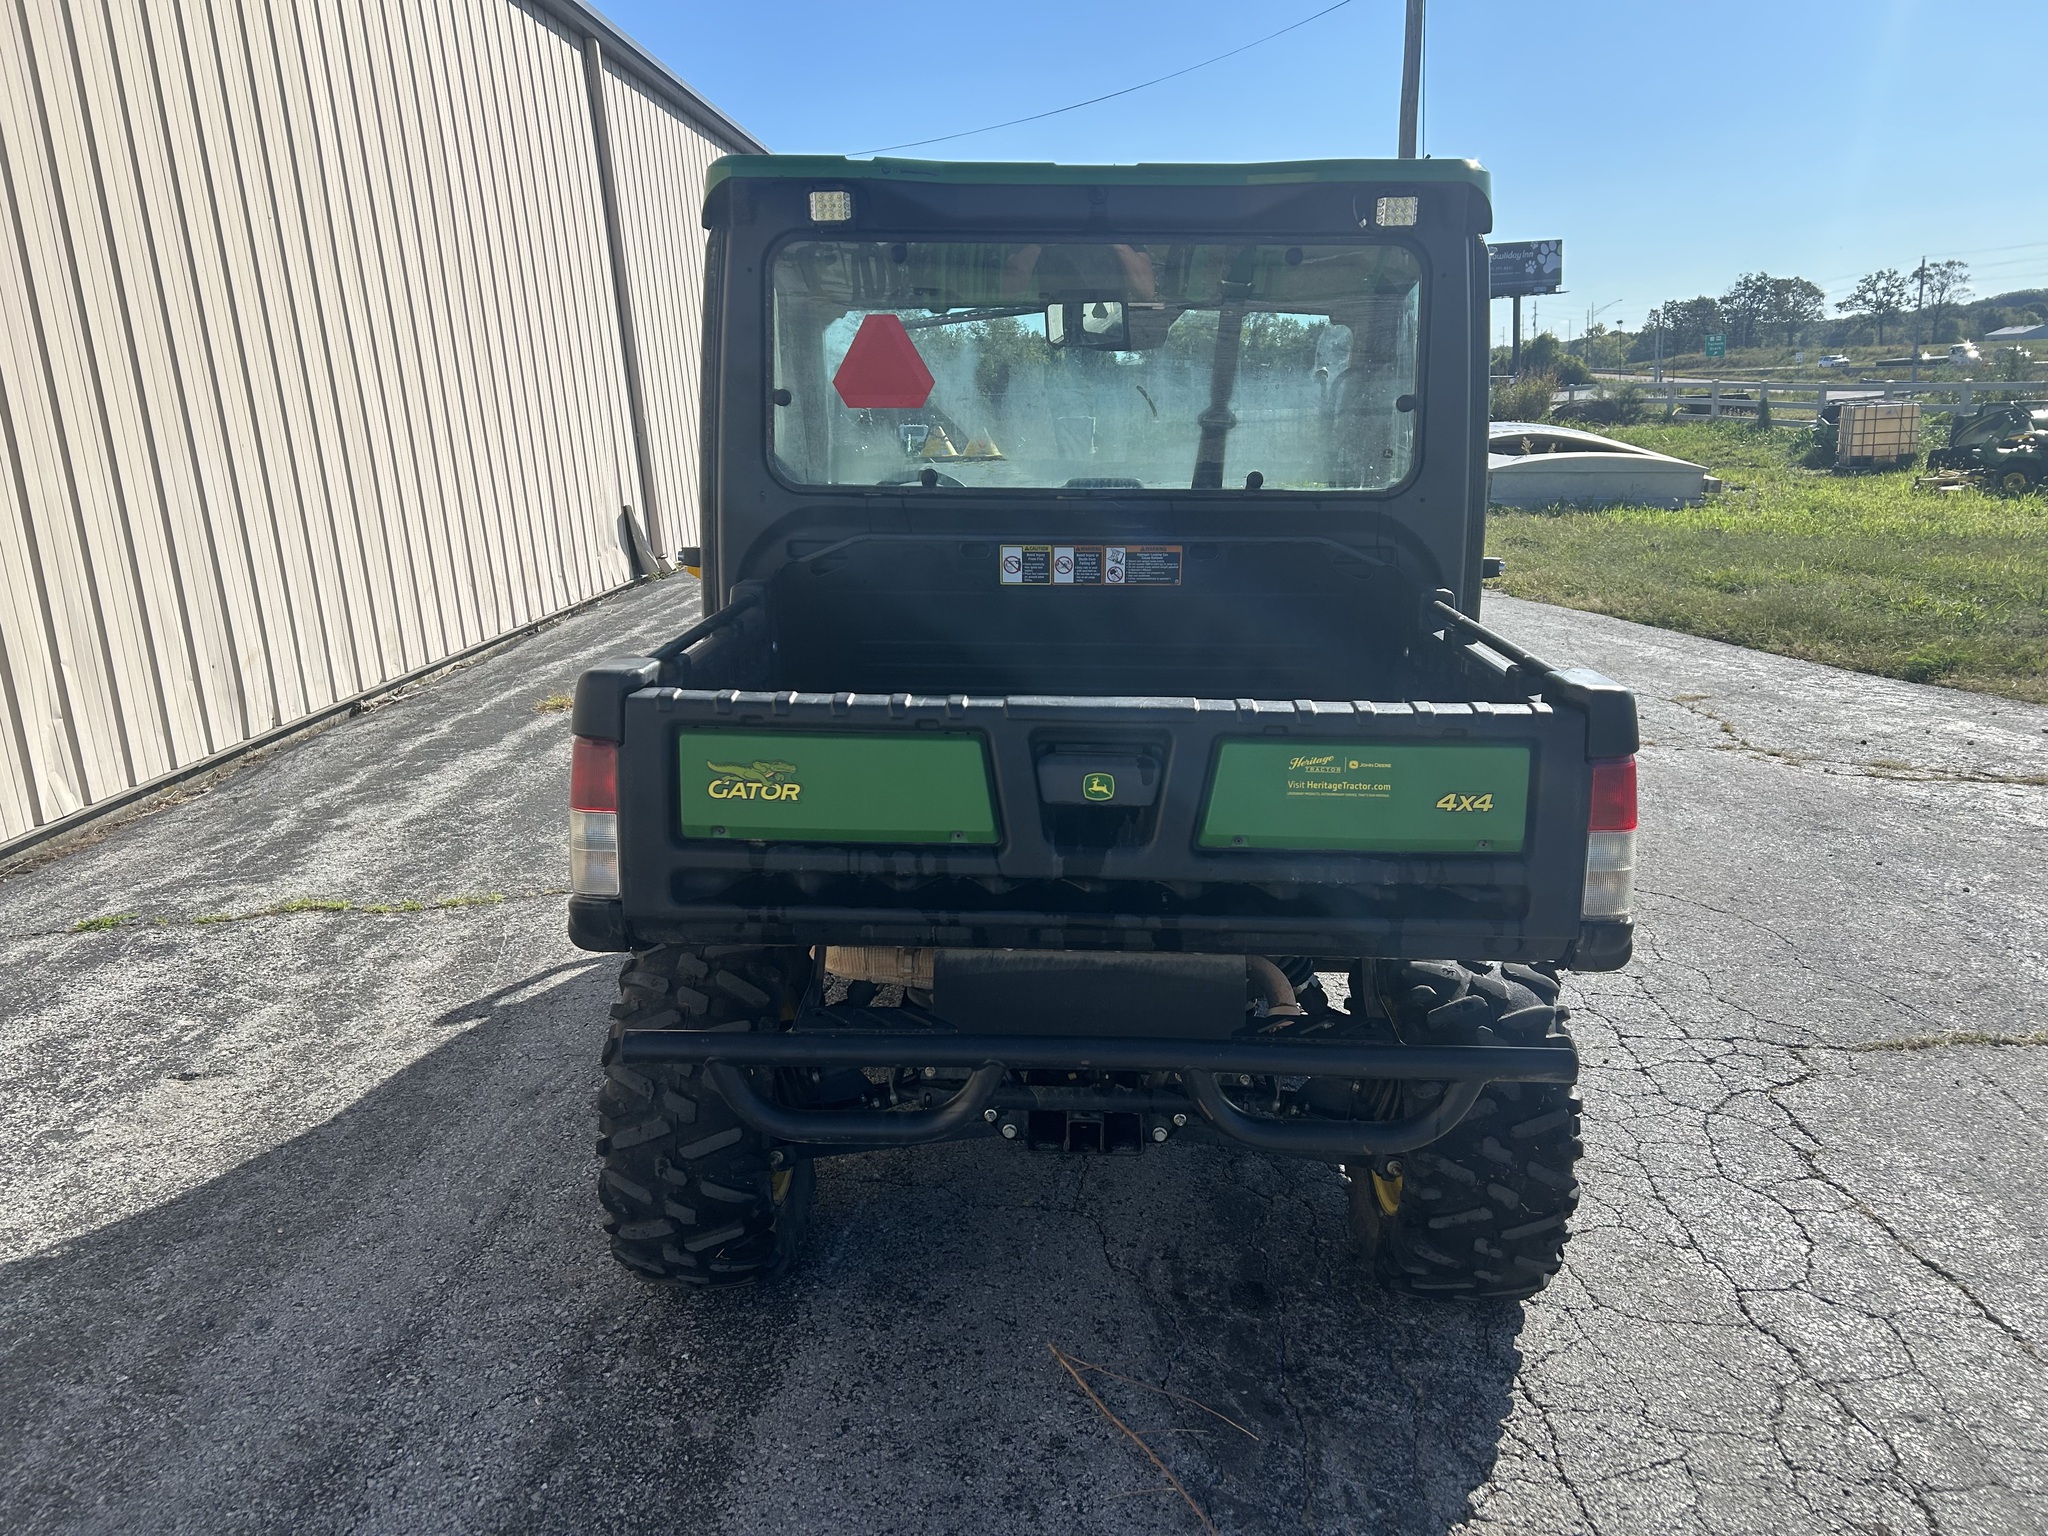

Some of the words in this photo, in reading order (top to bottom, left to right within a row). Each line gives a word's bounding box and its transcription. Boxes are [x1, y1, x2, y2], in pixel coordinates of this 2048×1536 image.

[1522, 249, 1534, 258] Inn
[1288, 755, 1334, 770] Heritage
[708, 779, 801, 801] GATOR
[1287, 780, 1305, 789] Visit
[1307, 781, 1391, 791] HeritageTractor.com
